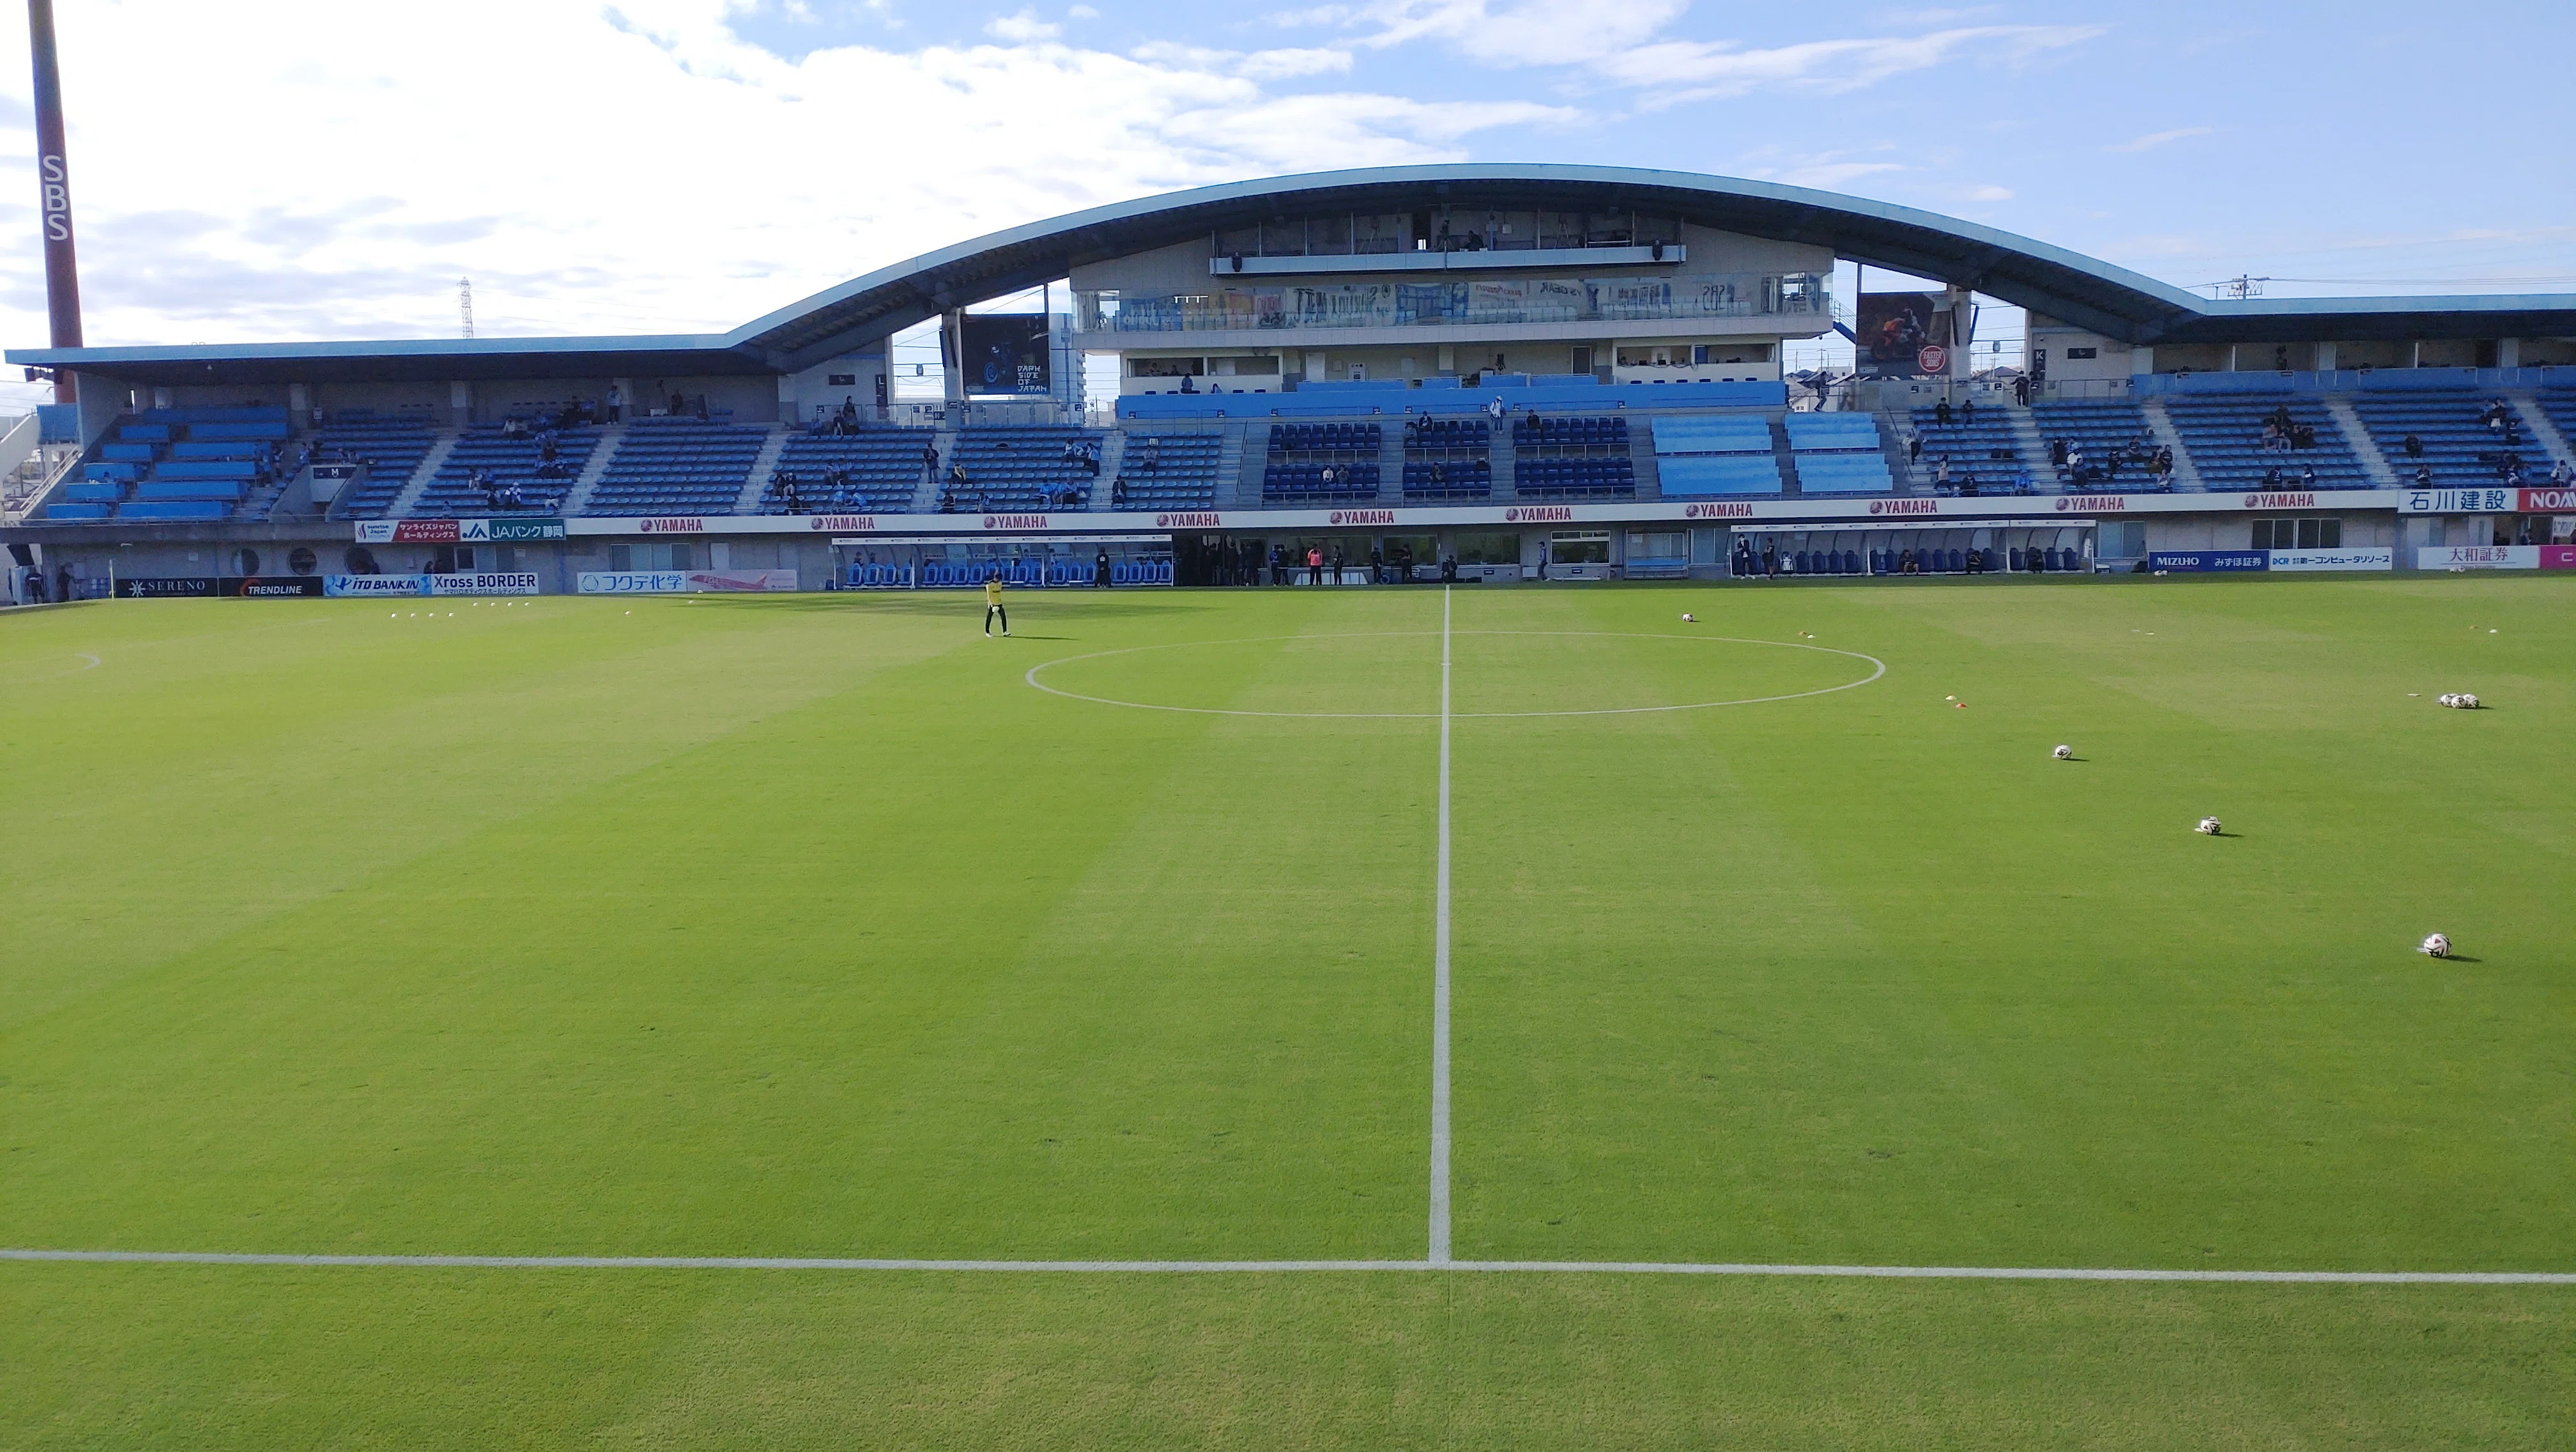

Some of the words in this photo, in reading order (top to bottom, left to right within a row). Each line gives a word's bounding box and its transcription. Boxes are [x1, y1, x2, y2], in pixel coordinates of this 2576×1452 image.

[43, 155, 68, 240] SBS
[2036, 351, 2043, 360] K
[1885, 500, 1937, 513] YAMAHA
[2071, 497, 2125, 511] YAMAHA
[2260, 493, 2315, 507] YAMAHA
[2409, 490, 2506, 511] 石川建設
[1344, 511, 1394, 523] YAMAHA
[1521, 507, 1572, 520] YAMAHA
[1700, 504, 1753, 517] YAMAHA
[654, 519, 703, 531] YAMAHA
[825, 517, 875, 530] YAMAHA
[997, 516, 1048, 528] YAMAHA
[1170, 514, 1220, 527] YAMAHA
[2449, 546, 2508, 562] 大和証券
[2157, 557, 2200, 566] MIZUHO
[2214, 557, 2262, 567] みずほ証券
[148, 580, 206, 591] SERENO
[373, 580, 420, 589] BANKIN
[434, 576, 473, 588] Xross
[477, 575, 535, 587] BORDER
[248, 585, 302, 594] TRENDLINE
